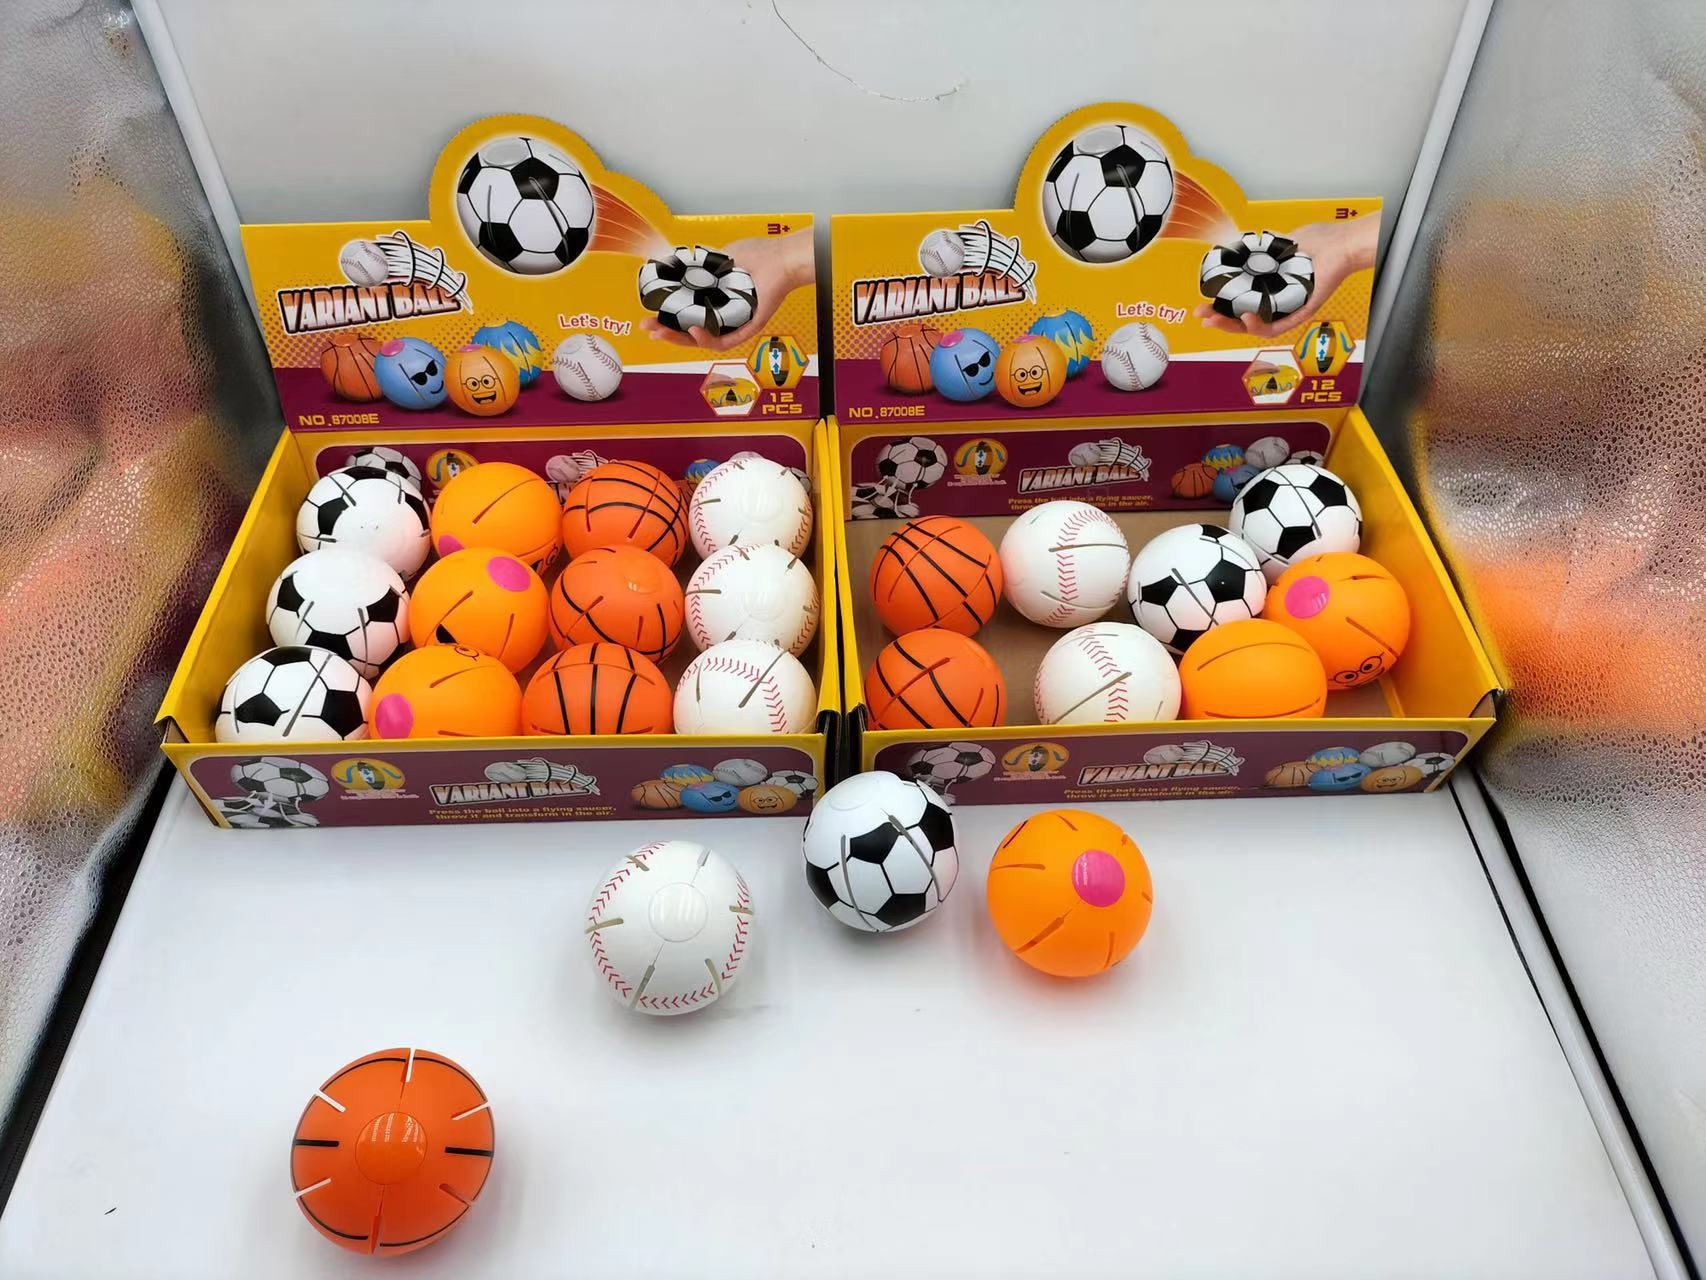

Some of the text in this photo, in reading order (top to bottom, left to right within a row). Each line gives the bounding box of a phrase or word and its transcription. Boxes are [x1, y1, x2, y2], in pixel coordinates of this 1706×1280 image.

[1335, 207, 1358, 219] 3+
[767, 223, 790, 235] 3+
[280, 282, 459, 332] VARIANT BALL
[855, 272, 1024, 324] VARIANT BALL
[1117, 302, 1185, 322] Let's try!
[558, 314, 632, 335] Let's try!
[1311, 379, 1335, 390] 12
[769, 392, 794, 403] 12
[1301, 391, 1342, 403] PCS
[762, 403, 802, 415] PCS
[1020, 465, 1097, 492] VARIANT
[1096, 463, 1140, 483] BALL
[1080, 762, 1175, 785] VARIANT
[1173, 760, 1228, 777] BALL
[432, 781, 528, 804] VARIANT
[529, 780, 589, 798] BALL
